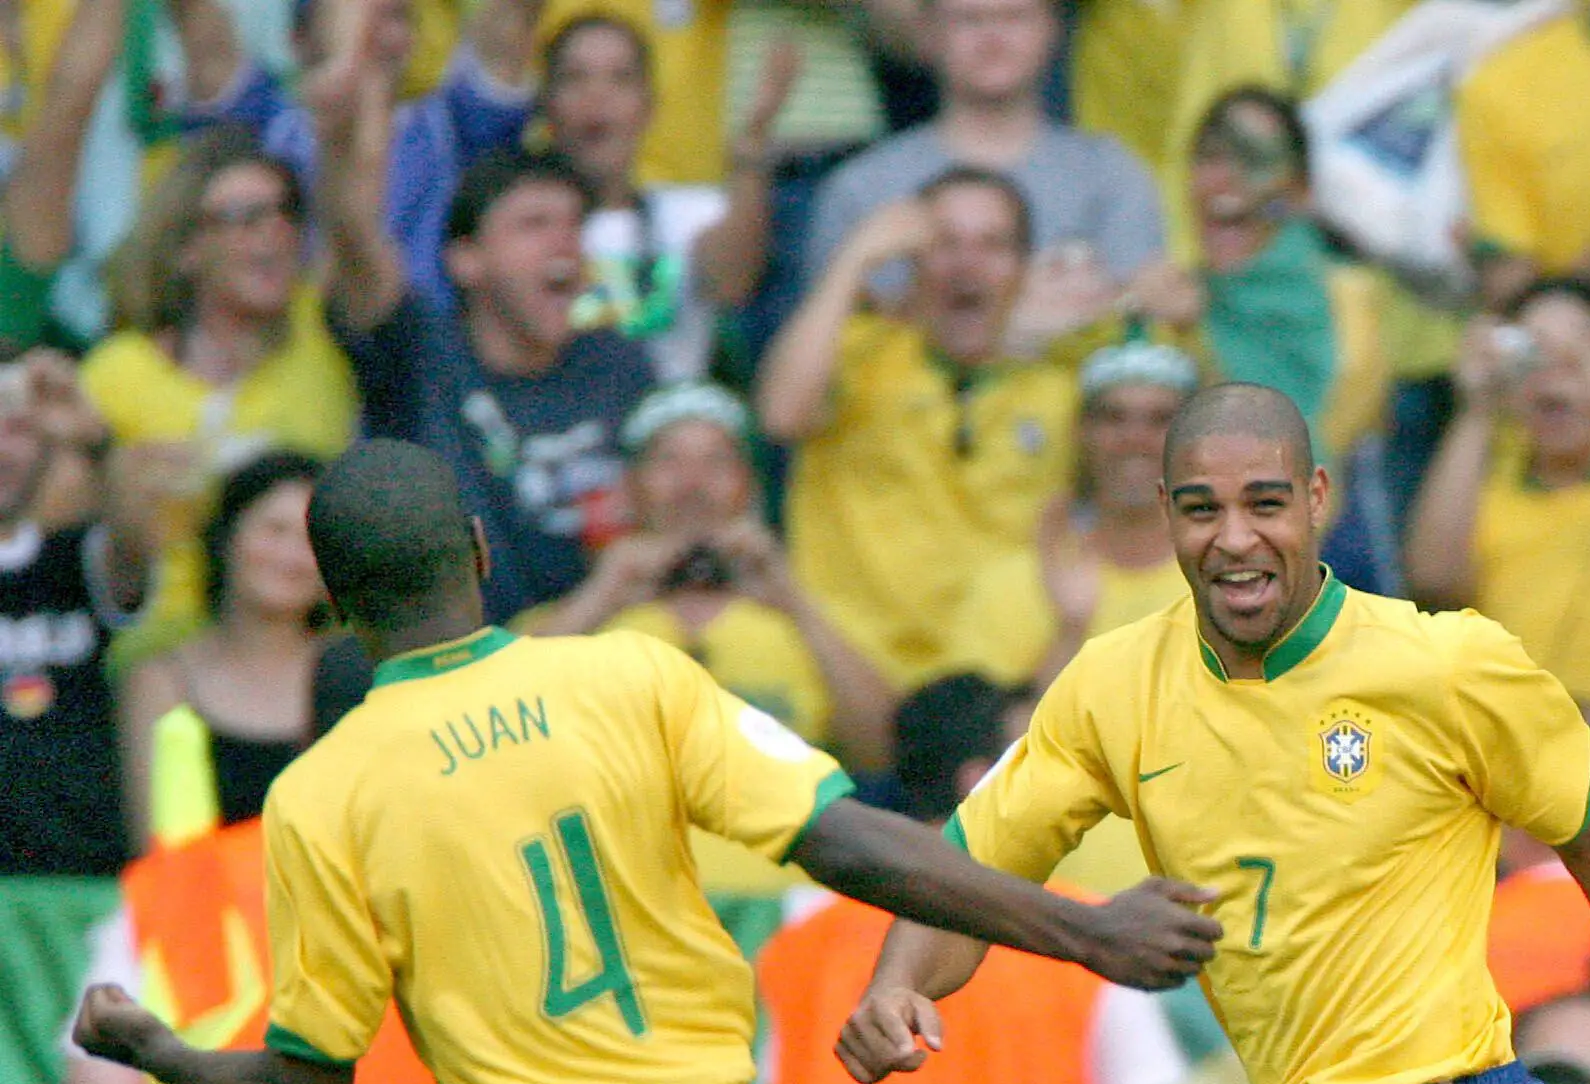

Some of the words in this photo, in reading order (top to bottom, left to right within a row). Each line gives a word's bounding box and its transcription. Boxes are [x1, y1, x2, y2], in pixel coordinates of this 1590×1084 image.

[430, 696, 550, 776] JUAN
[517, 807, 649, 1037] 4
[1236, 856, 1276, 949] 7
